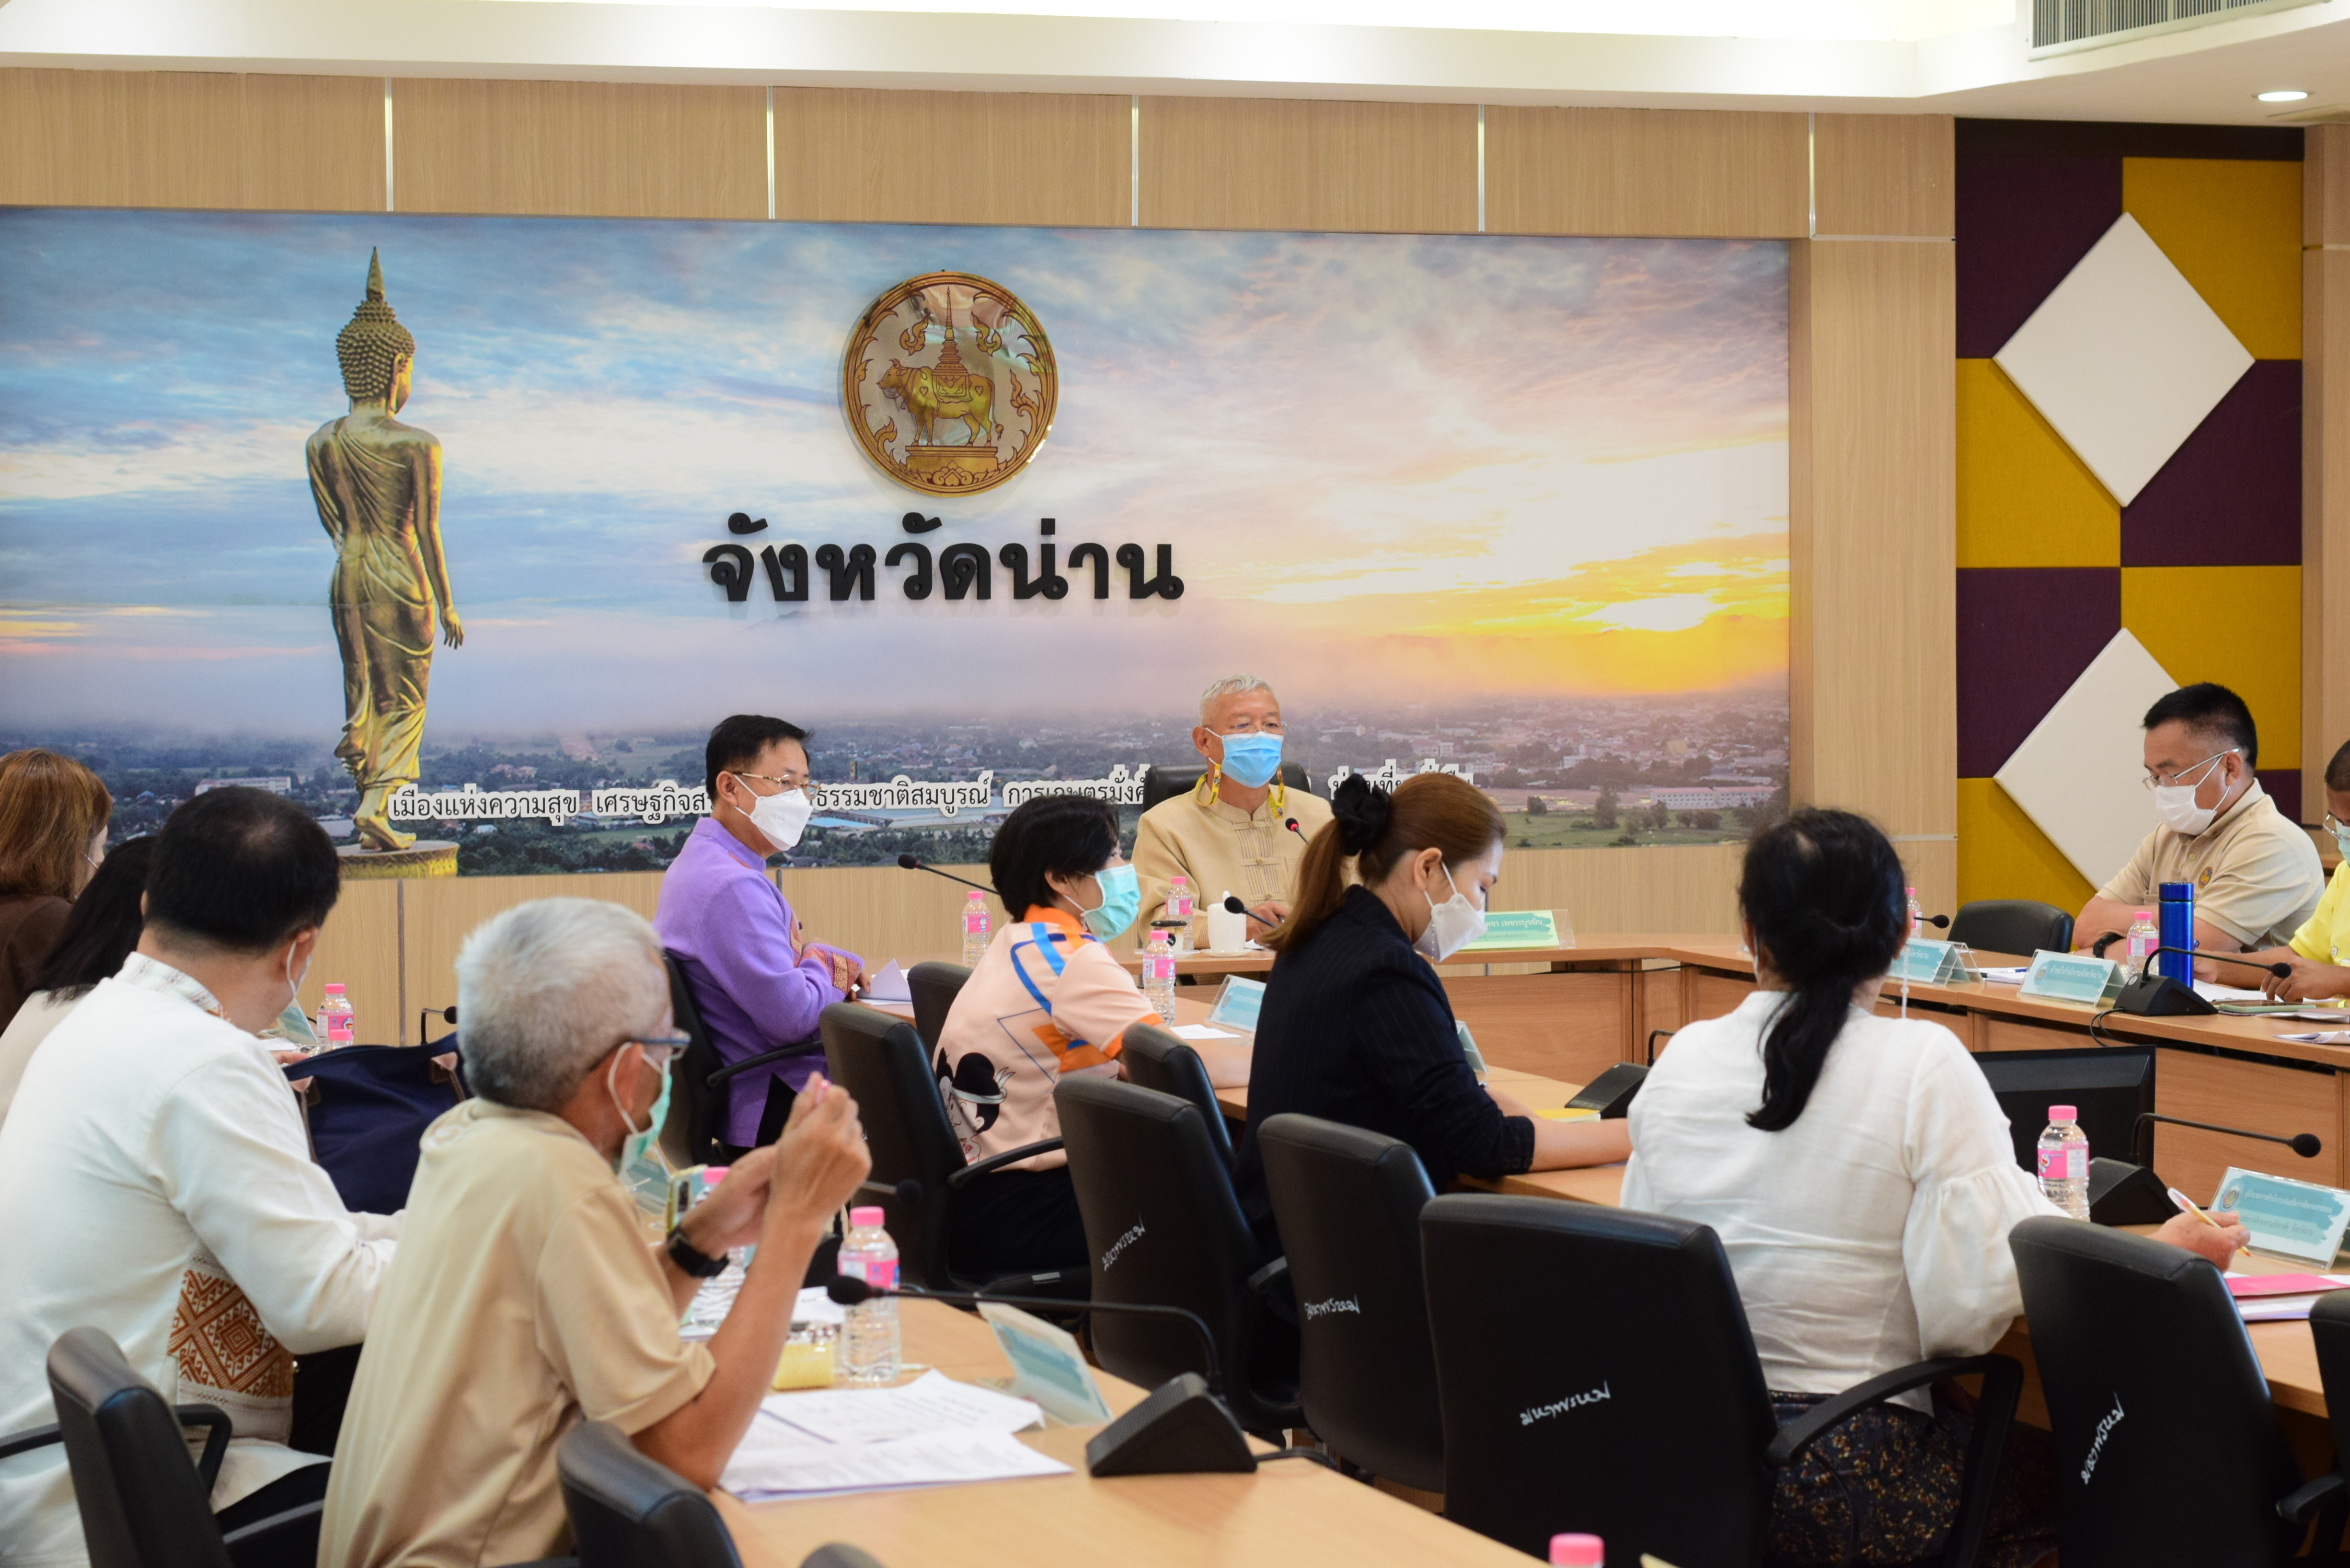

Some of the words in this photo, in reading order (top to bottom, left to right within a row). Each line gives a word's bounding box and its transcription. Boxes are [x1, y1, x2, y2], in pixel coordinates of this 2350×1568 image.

[701, 511, 1185, 602] จังหวัดน่าน
[392, 788, 577, 823] เมืองแห่งความสุข
[595, 786, 714, 821] เศรษฐกิจส
[815, 776, 988, 814] ธรรมชาติสมบูรณ์
